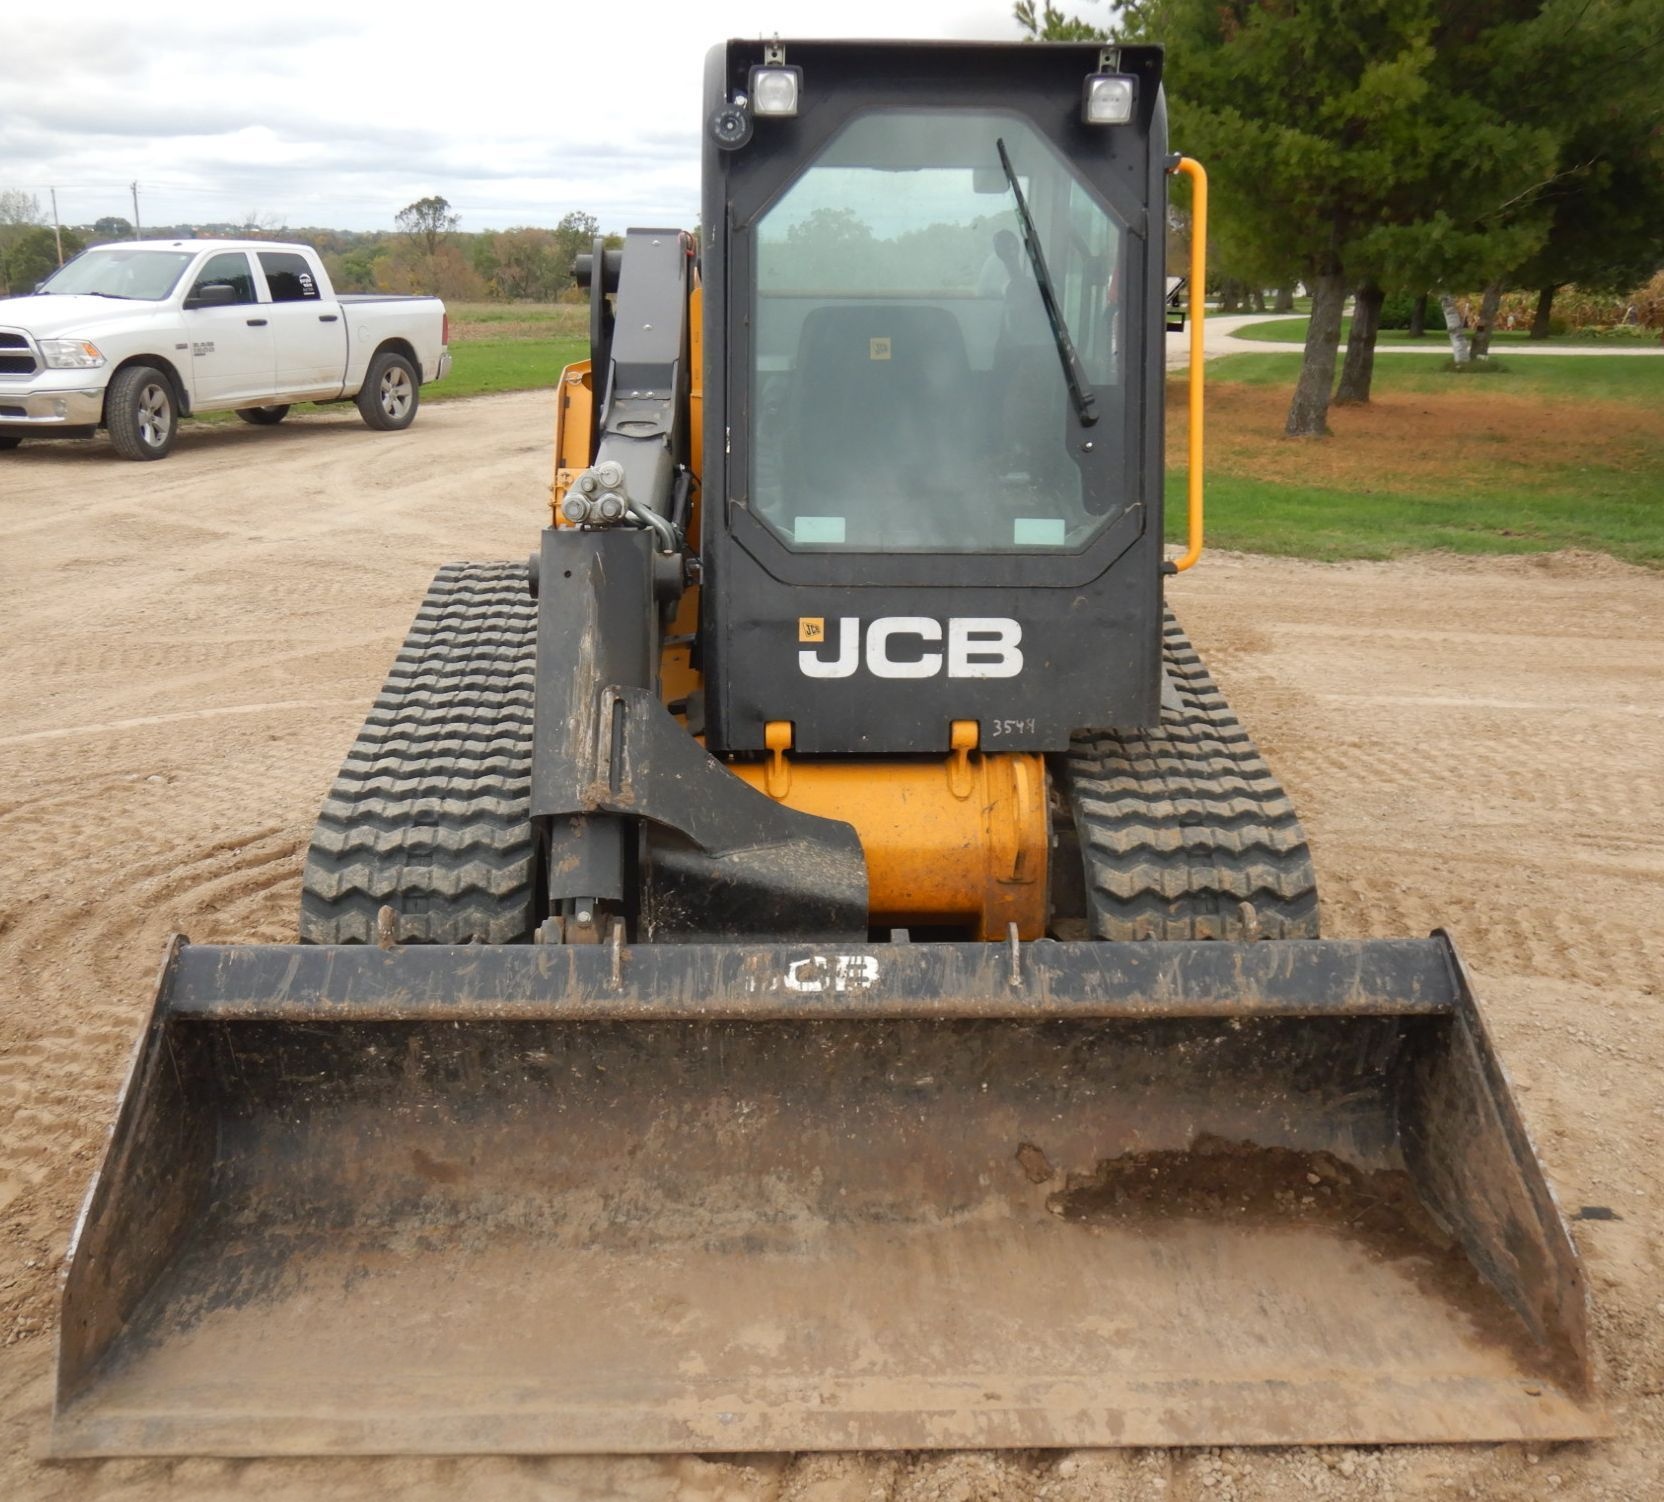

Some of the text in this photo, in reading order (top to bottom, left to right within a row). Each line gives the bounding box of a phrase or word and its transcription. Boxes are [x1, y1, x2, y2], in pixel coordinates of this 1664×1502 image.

[799, 616, 1024, 678] JCB
[992, 718, 1036, 737] 3544
[744, 955, 880, 992] CB
